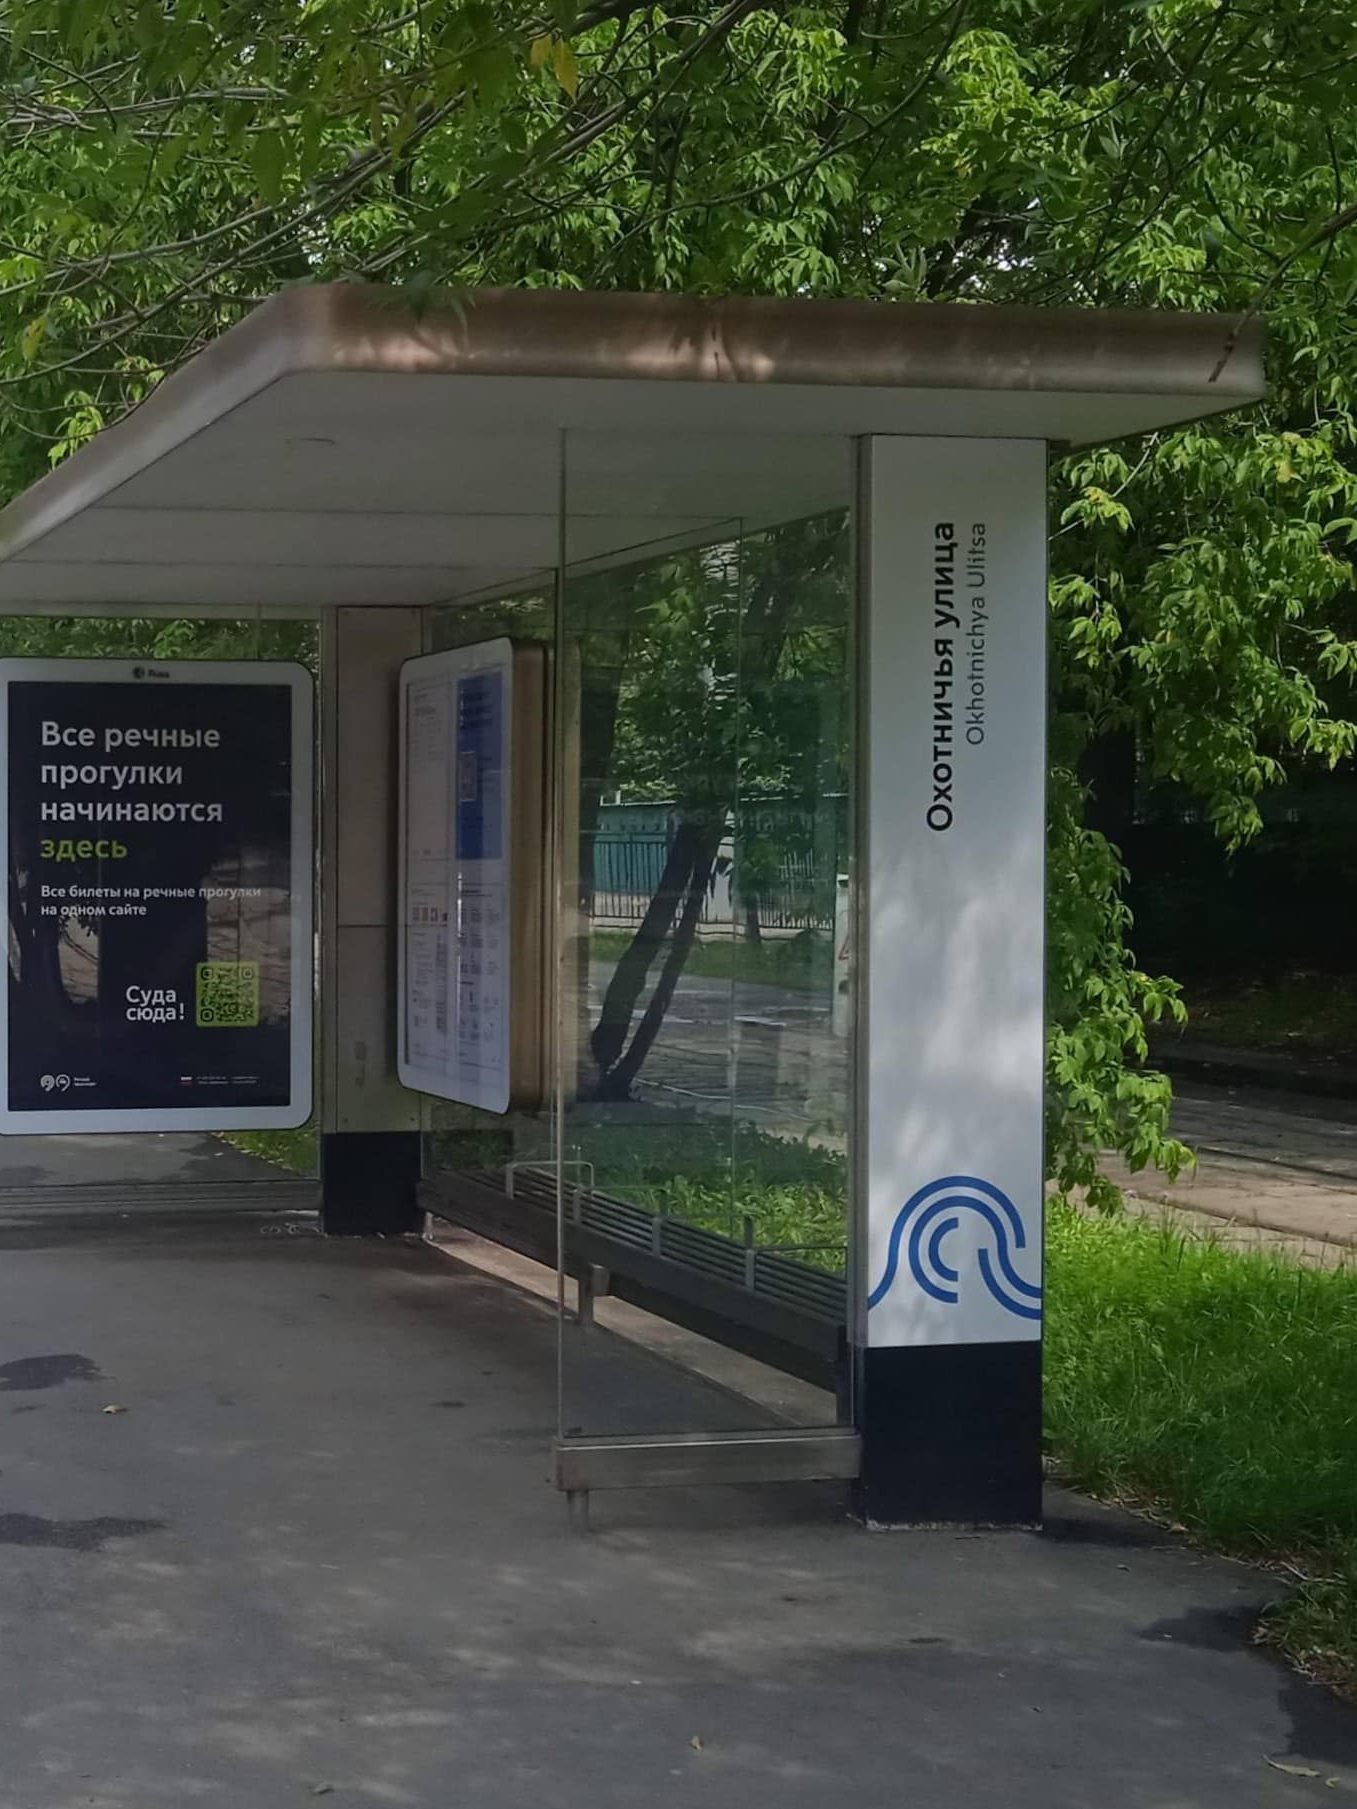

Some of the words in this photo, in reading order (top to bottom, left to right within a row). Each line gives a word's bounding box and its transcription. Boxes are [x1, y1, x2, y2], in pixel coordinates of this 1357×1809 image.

[967, 523, 986, 588] Ulitsa
[934, 522, 960, 628] улица
[966, 596, 989, 745] Okhotnichya
[42, 721, 95, 747] Все
[105, 728, 221, 752] речные
[926, 638, 954, 832] Охотничья
[41, 764, 183, 790] прогулки
[41, 802, 223, 823] начинаются
[41, 839, 128, 862] здесь
[41, 885, 66, 898] Все
[69, 884, 121, 898] билеты
[124, 887, 140, 898] на
[143, 887, 195, 902] речные
[199, 887, 261, 902] прогулки
[41, 905, 57, 916] на
[60, 905, 106, 919] одном
[108, 903, 147, 916] сайте
[125, 984, 177, 1006] Суда
[125, 1003, 185, 1022] сюда!
